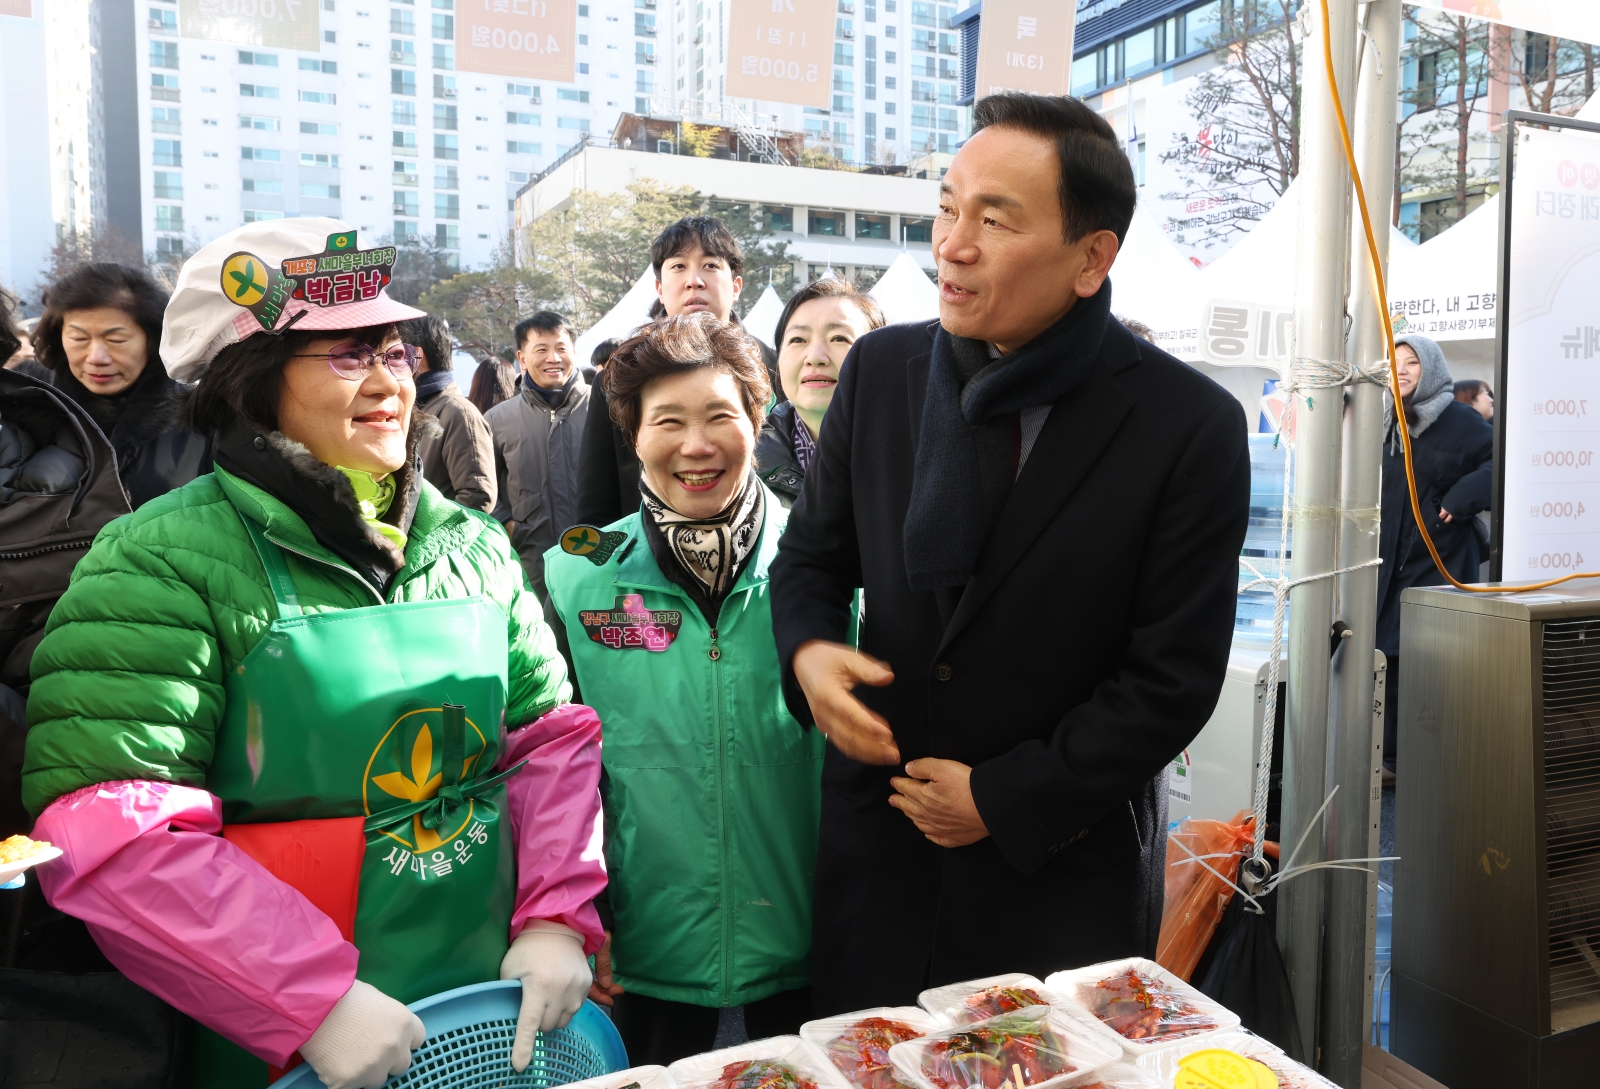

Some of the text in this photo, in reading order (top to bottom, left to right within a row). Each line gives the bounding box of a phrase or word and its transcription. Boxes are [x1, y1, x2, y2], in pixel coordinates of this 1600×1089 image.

[1185, 199, 1206, 214] 새로운
[283, 248, 396, 276] 개포3 새마을부녀회장
[306, 269, 382, 307] 박금남
[1446, 296, 1460, 313] 내
[1466, 292, 1497, 312] 고향
[580, 612, 680, 626] 강남구 새마을부녀회장
[601, 626, 667, 648] 박조연
[381, 821, 489, 882] 새마을운동
